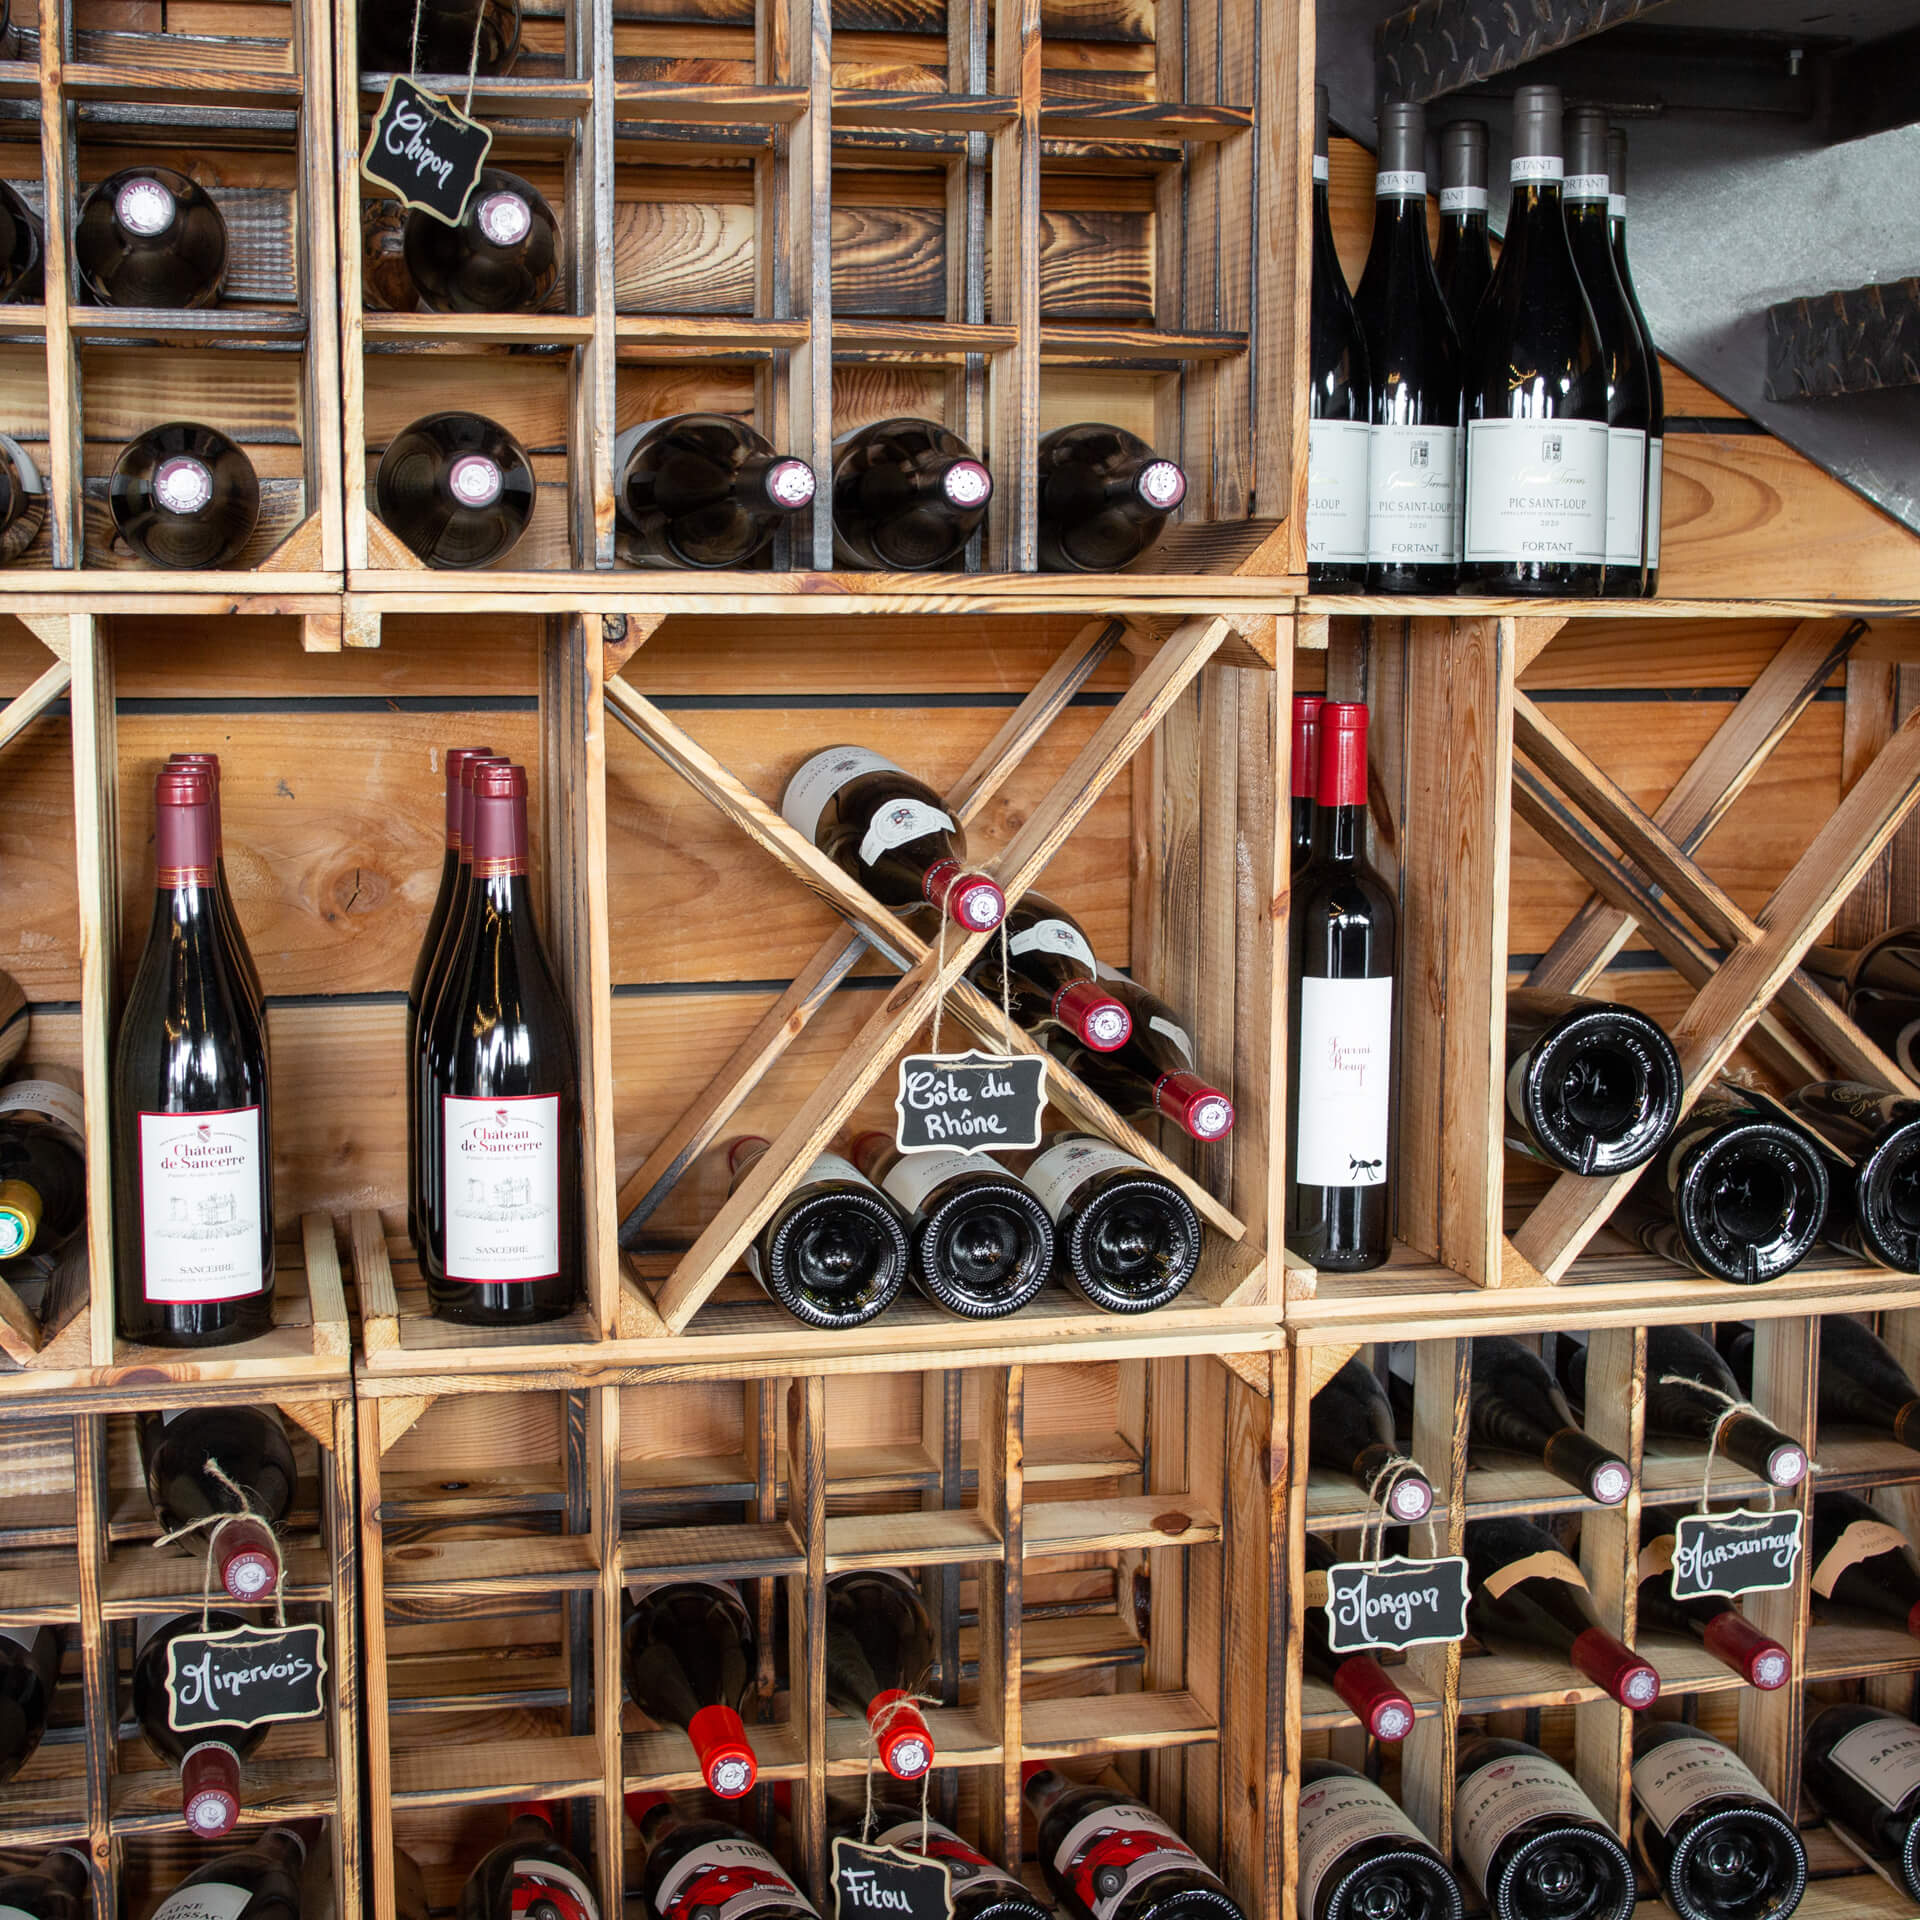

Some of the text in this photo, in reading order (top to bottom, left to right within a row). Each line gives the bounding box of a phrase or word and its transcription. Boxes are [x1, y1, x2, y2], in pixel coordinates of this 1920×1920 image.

[385, 100, 454, 190] Chinon
[1378, 501, 1451, 513] PIC SAINT-LOUP
[1508, 497, 1587, 511] PIC SAINT-LOUP
[1391, 543, 1440, 553] FORTANT
[1521, 541, 1574, 553] FORTANT
[907, 1071, 1015, 1110] Côte du
[924, 1108, 1007, 1140] Rhône
[473, 1127, 529, 1140] Château
[174, 1143, 232, 1157] Château
[460, 1139, 543, 1152] de Sancerre
[160, 1154, 245, 1170] de Sancerre
[179, 1263, 234, 1274] SANCERRE
[1336, 1574, 1439, 1642] Morgon
[179, 1652, 313, 1711] Minervois
[840, 1867, 914, 1914] Fitou
